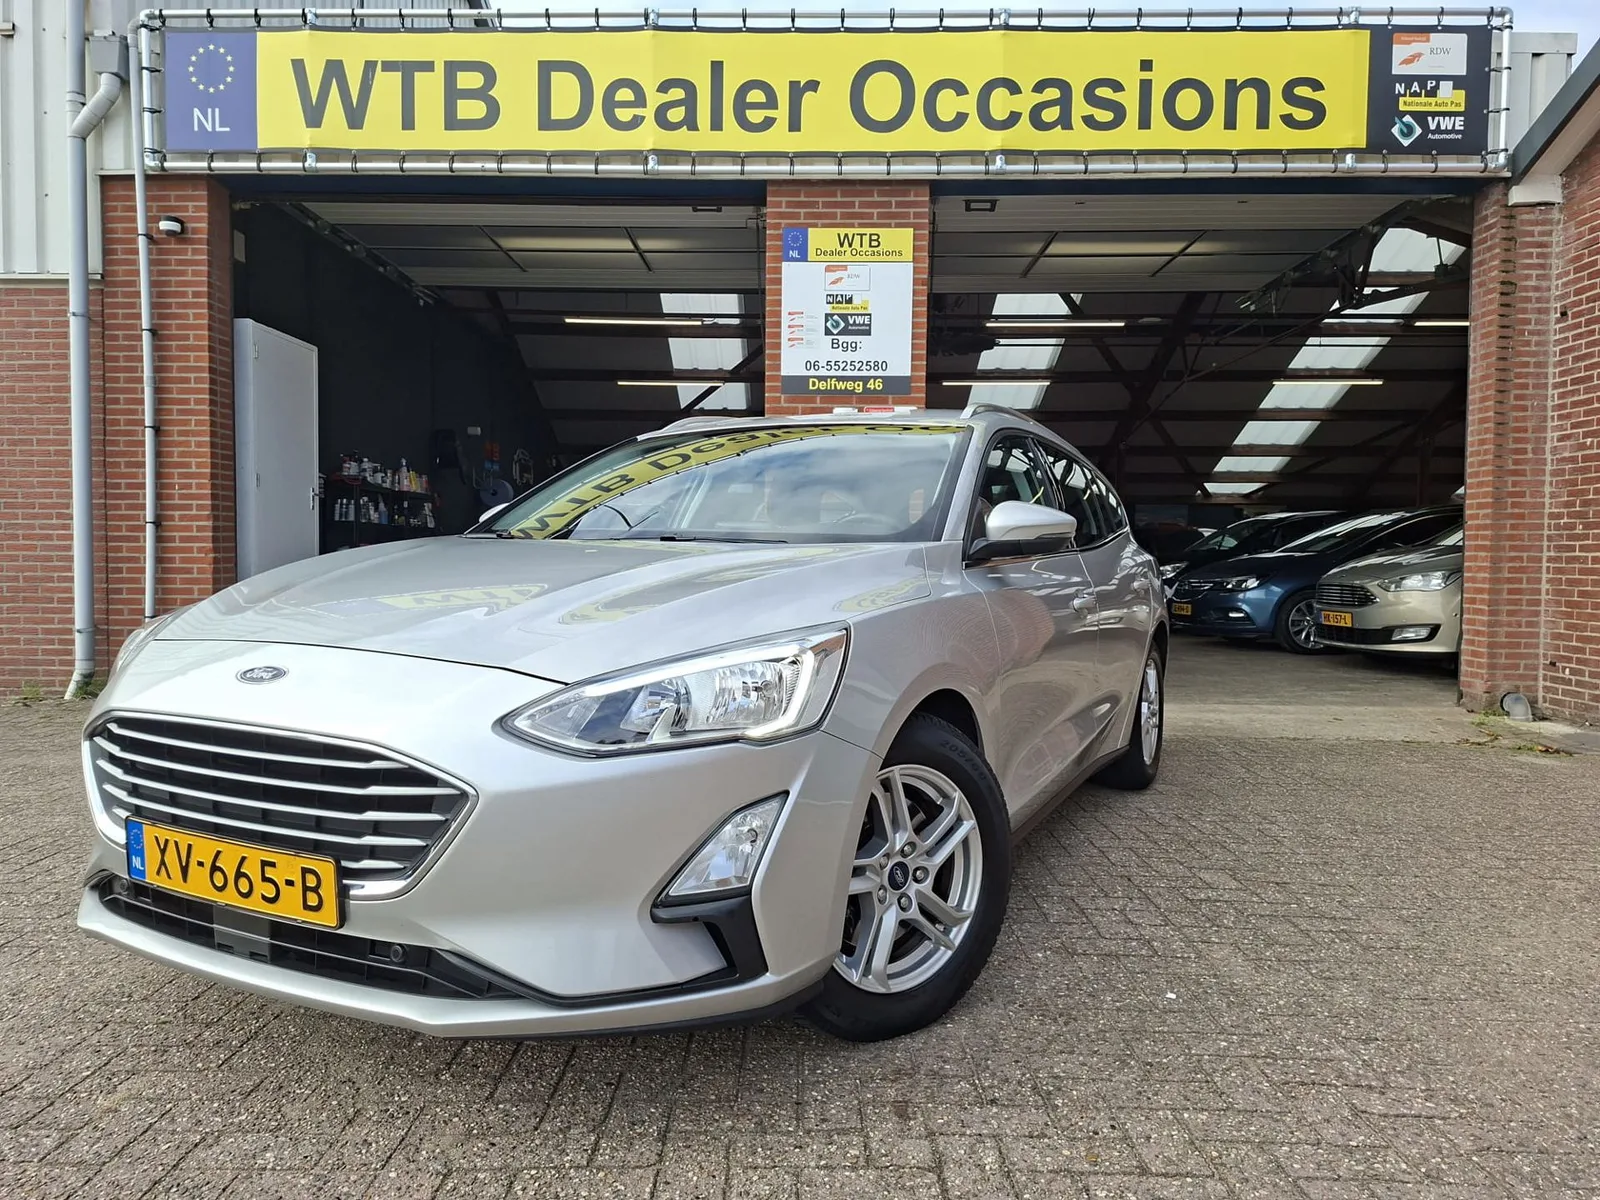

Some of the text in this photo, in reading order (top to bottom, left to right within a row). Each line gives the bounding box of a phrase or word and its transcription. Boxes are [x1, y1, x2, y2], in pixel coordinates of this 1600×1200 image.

[1429, 47, 1452, 56] RDW
[290, 57, 1329, 134] WTB Dealer Occasions
[1450, 100, 1461, 108] Pas
[192, 107, 231, 133] NL
[1427, 116, 1465, 130] VWE
[837, 232, 881, 249] WTB
[788, 250, 801, 258] NL
[815, 247, 903, 257] Dealer Occasions
[847, 315, 871, 325] VWE
[831, 338, 863, 352] Bgg:
[805, 360, 888, 372] 06-55252580
[808, 378, 883, 393] Delfweg 46
[132, 855, 145, 871] NL
[154, 835, 324, 913] XV-665-B
